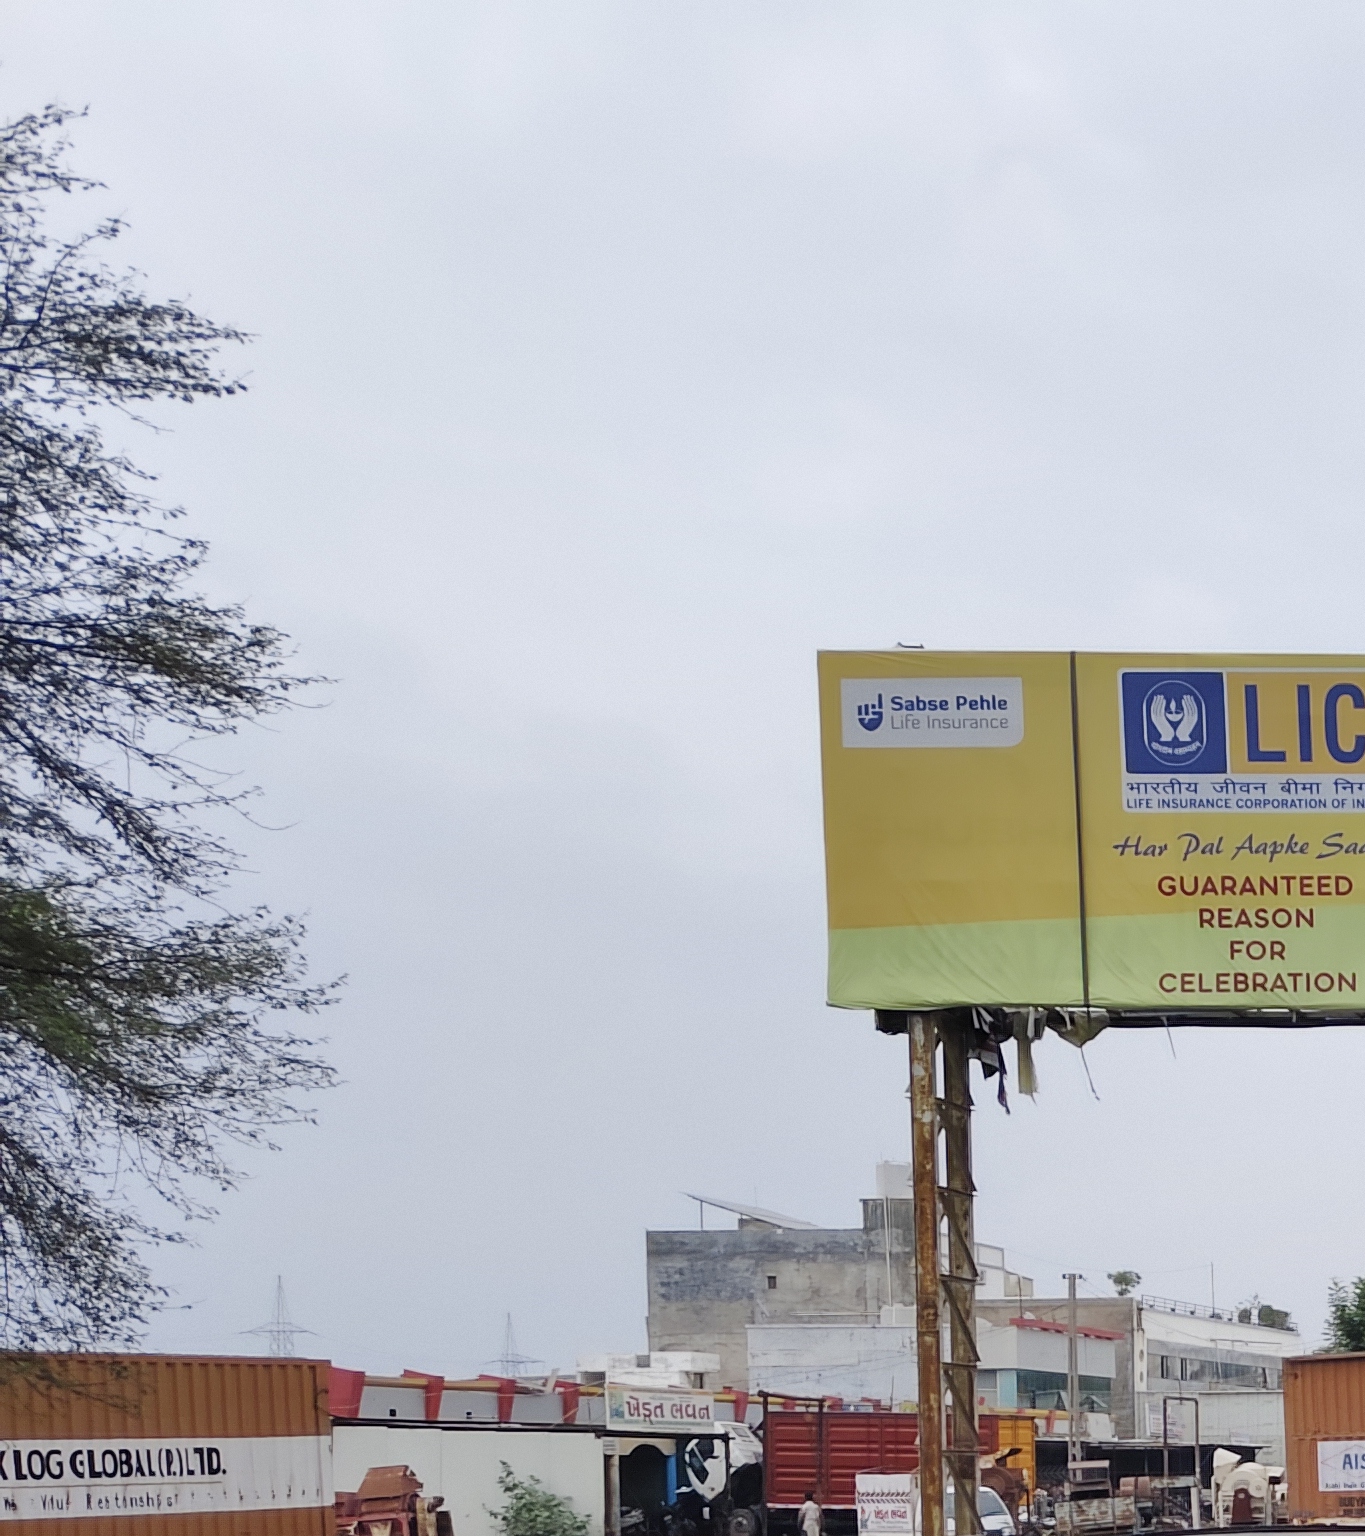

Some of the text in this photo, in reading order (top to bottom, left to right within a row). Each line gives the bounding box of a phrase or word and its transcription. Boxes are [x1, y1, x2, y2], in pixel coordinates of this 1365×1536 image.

[890, 695, 1008, 711] Sabse Pehle
[890, 713, 1009, 730] Life Insurance
[1126, 778, 1199, 795] भारतीय
[1212, 778, 1267, 795] जीवन
[1280, 778, 1322, 795] बीमा
[1126, 798, 1153, 809] LIFE
[1157, 798, 1232, 809] INSURANCE
[1236, 798, 1327, 809] CORPORATION
[1331, 798, 1347, 809] OF
[1112, 835, 1168, 858] Har
[1176, 832, 1224, 862] Pal
[1231, 832, 1310, 863] Aapke
[1157, 875, 1354, 897] GUARANTEED
[1198, 908, 1315, 929] REASON
[1229, 940, 1286, 961] FOR
[1158, 972, 1357, 994] CELEBRATION
[670, 1403, 711, 1420] ભવન
[12, 1449, 64, 1481] LOG
